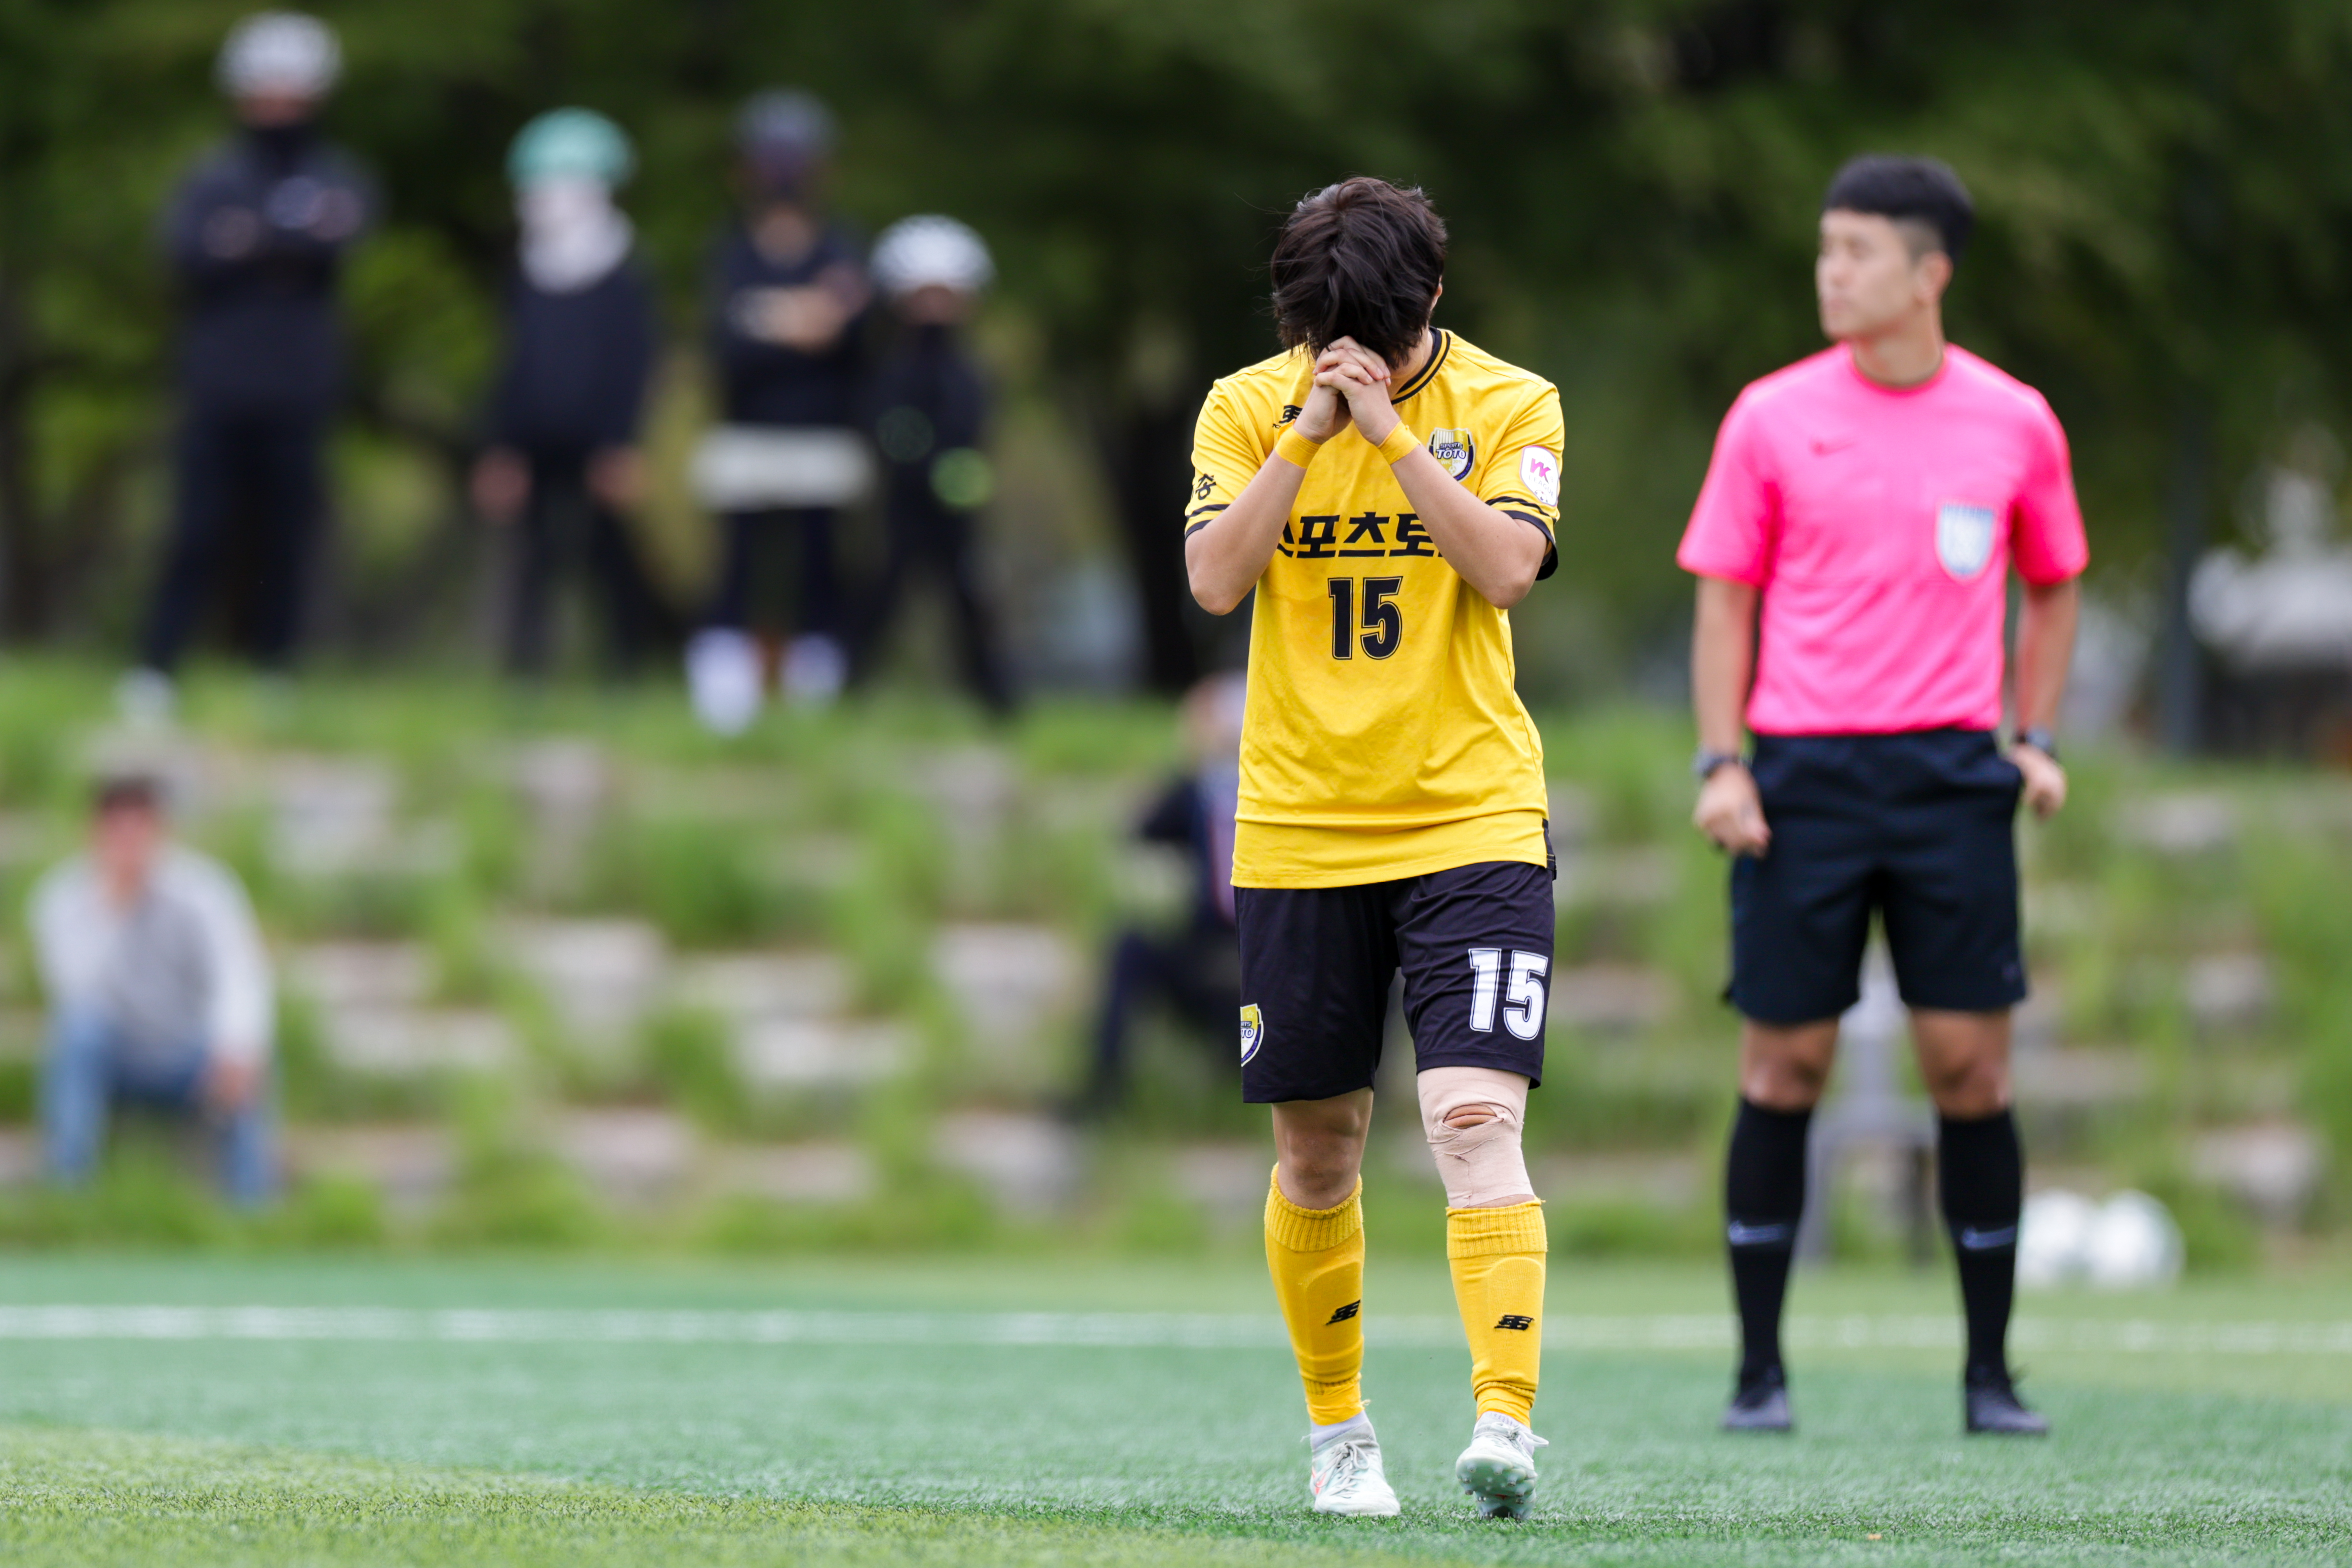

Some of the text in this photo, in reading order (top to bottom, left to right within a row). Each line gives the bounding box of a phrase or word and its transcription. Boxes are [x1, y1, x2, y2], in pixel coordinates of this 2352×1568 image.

[1435, 449, 1466, 459] TOTO
[1191, 473, 1217, 500] 종
[1528, 475, 1554, 498] LEAGUE
[1277, 512, 1443, 559] 포츠토
[1327, 576, 1403, 660] 15
[1468, 948, 1549, 1041] 15
[1241, 1028, 1255, 1038] TO
